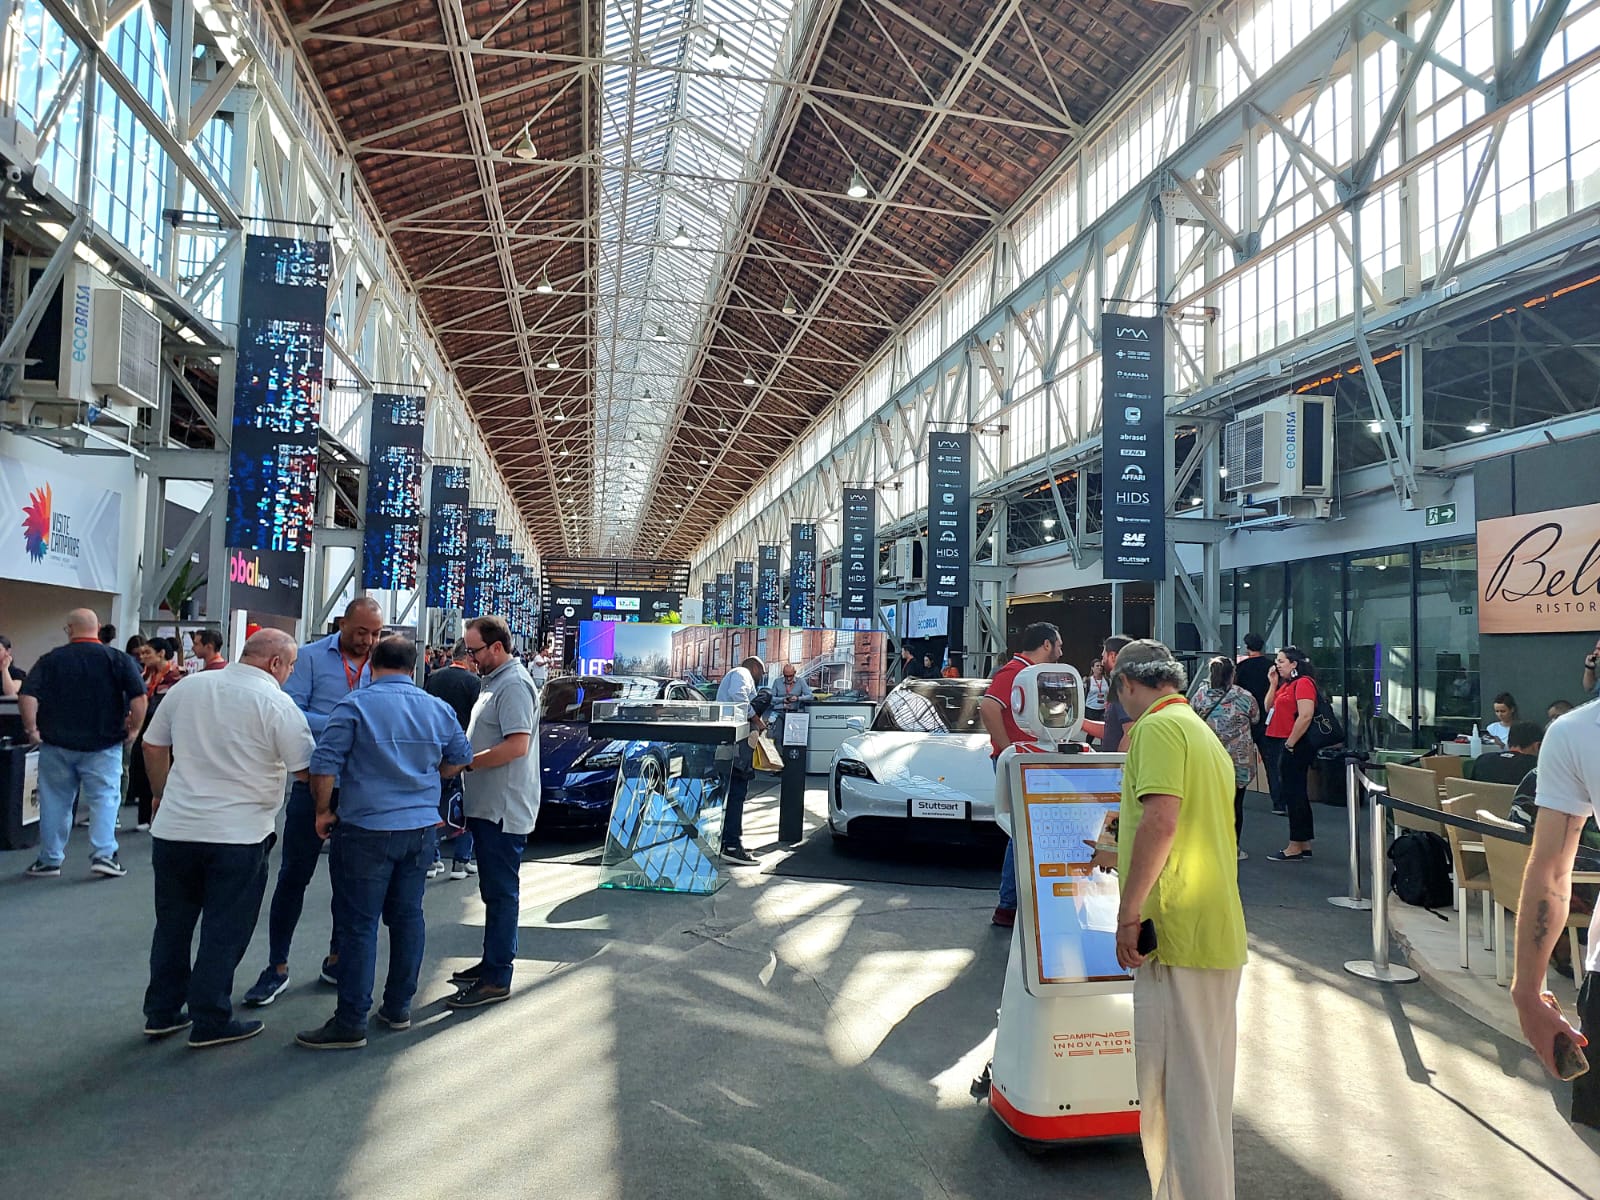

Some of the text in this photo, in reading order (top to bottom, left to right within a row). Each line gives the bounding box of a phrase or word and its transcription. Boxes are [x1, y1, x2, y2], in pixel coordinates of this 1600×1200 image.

[1116, 491, 1150, 504] HIDS
[52, 512, 71, 535] VISITE
[1122, 533, 1147, 541] SAE
[936, 548, 959, 557] HIDS
[1485, 522, 1600, 602] Bel
[1053, 1031, 1130, 1040] CAMPINAS
[1054, 1040, 1131, 1049] INNOVATION
[1054, 1048, 1131, 1057] WEEK
